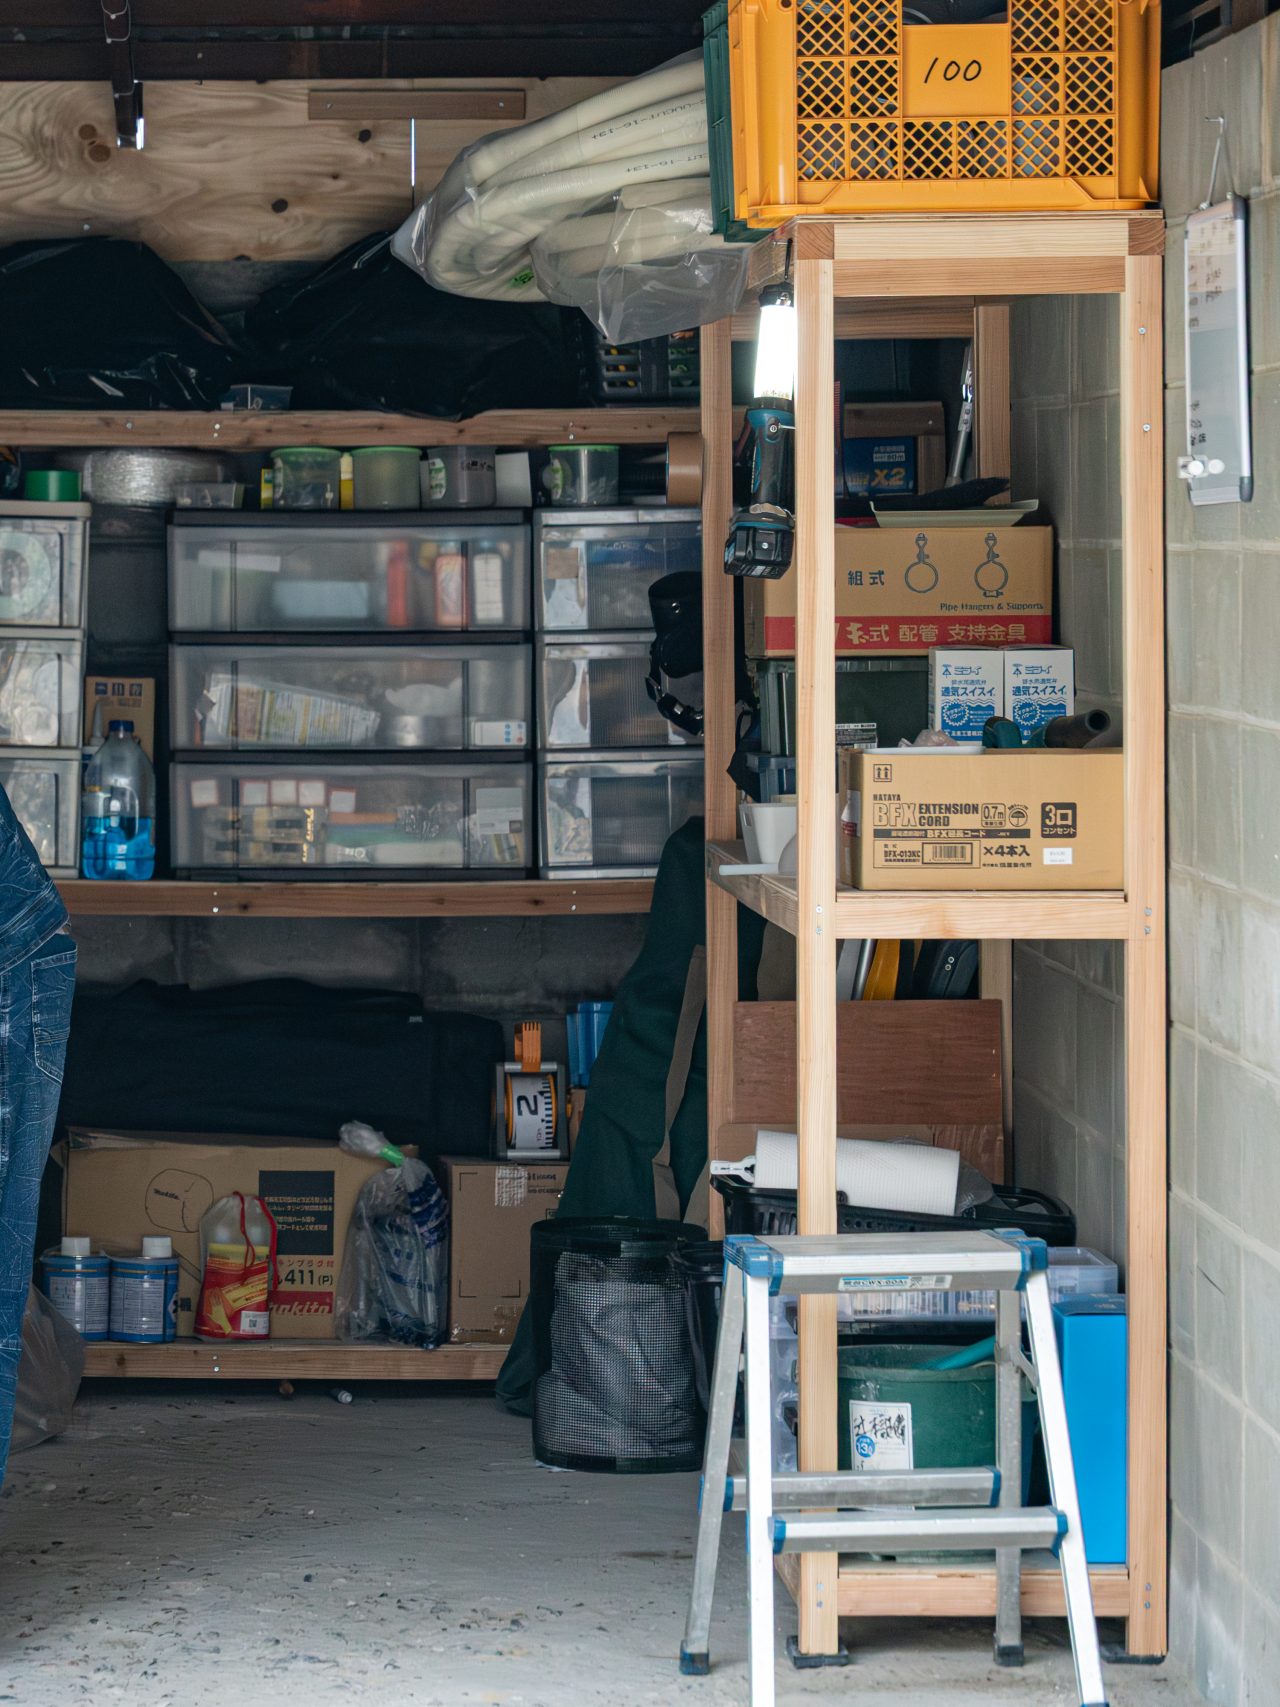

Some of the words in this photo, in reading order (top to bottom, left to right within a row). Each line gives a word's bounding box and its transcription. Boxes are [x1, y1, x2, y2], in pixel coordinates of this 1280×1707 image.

[924, 57, 982, 83] 100
[940, 602, 958, 611] Pipe
[961, 602, 994, 611] Hangers
[1006, 602, 1044, 611] Supports
[948, 624, 1027, 642] 支持金具
[873, 803, 917, 827] BFX
[919, 804, 979, 814] EXTENSION
[983, 805, 1004, 820] 0.7m
[1045, 804, 1073, 826] 3口
[919, 816, 950, 826] CORD
[1042, 827, 1076, 835] コンセント
